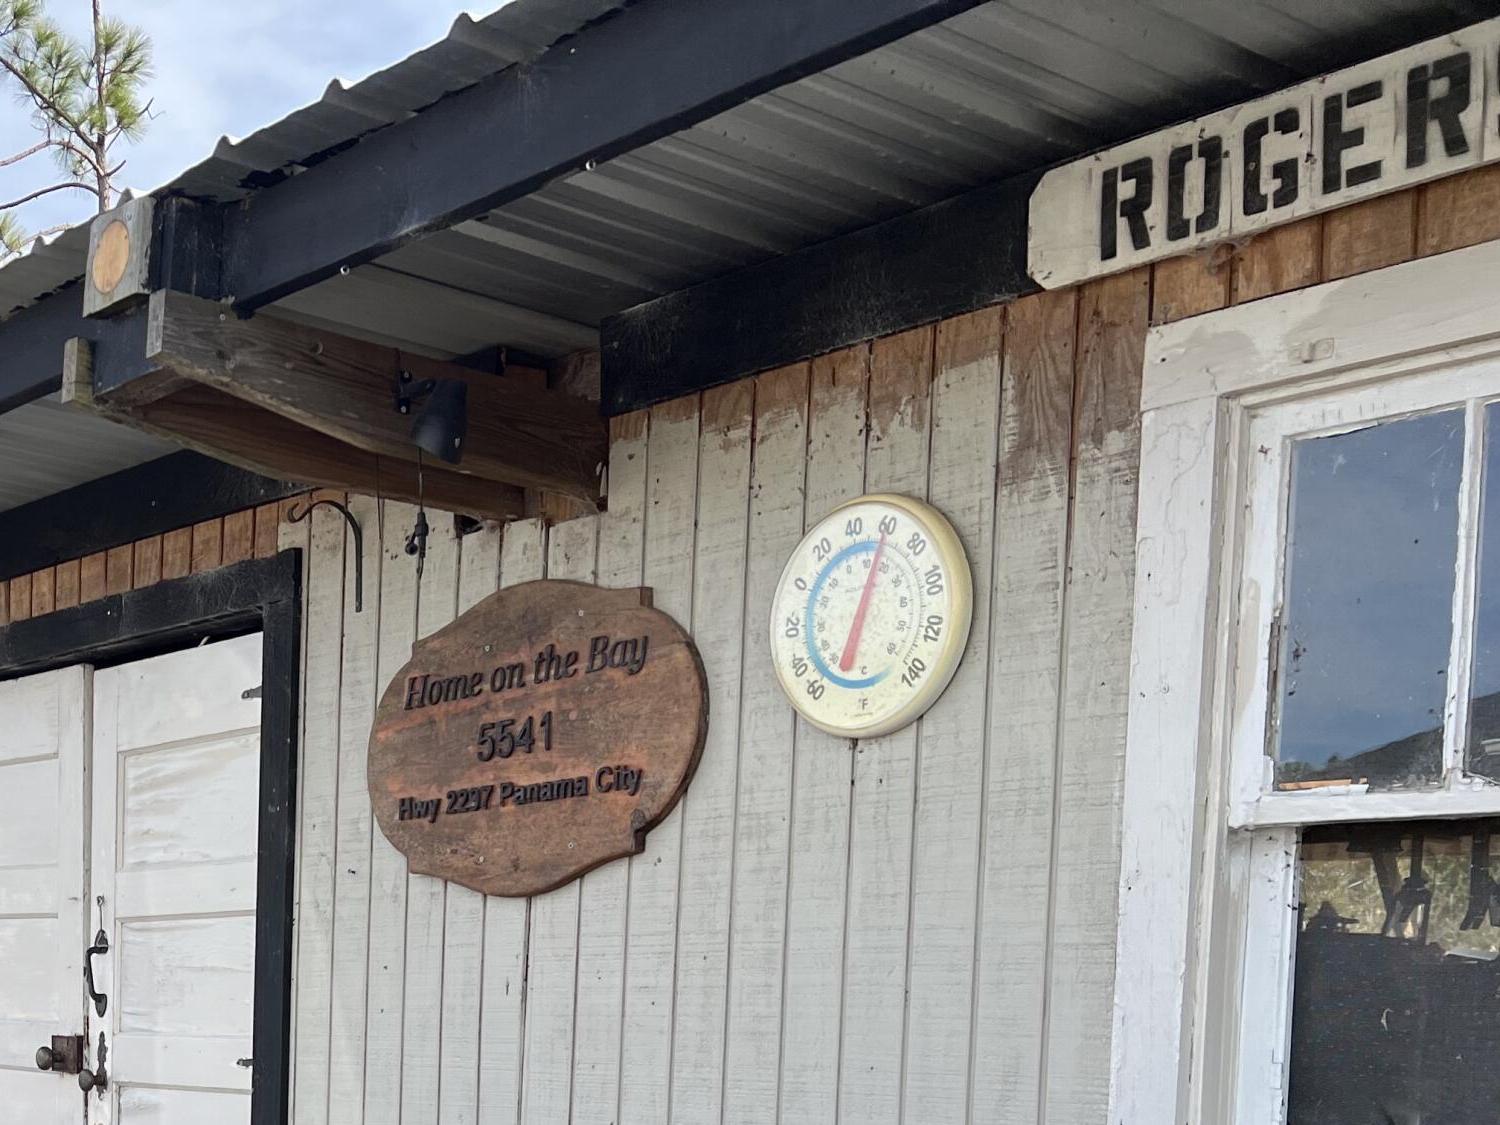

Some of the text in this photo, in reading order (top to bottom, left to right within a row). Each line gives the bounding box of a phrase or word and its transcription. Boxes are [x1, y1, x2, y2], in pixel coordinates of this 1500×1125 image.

[1100, 44, 1500, 262] ROGER
[845, 517, 863, 537] 40
[878, 514, 897, 535] 60
[812, 537, 832, 561] 20
[906, 532, 926, 556] 80
[794, 577, 808, 592] 0
[924, 564, 943, 596] 100
[785, 611, 800, 638] -20
[923, 615, 943, 642] 120
[404, 635, 649, 711] Home on the Bay
[792, 653, 808, 678] -40
[901, 657, 926, 688] 140
[806, 679, 825, 701] -60
[477, 711, 554, 762] 5541
[399, 796, 442, 823] Hwy
[499, 775, 589, 808] Panama
[595, 765, 643, 796] City
